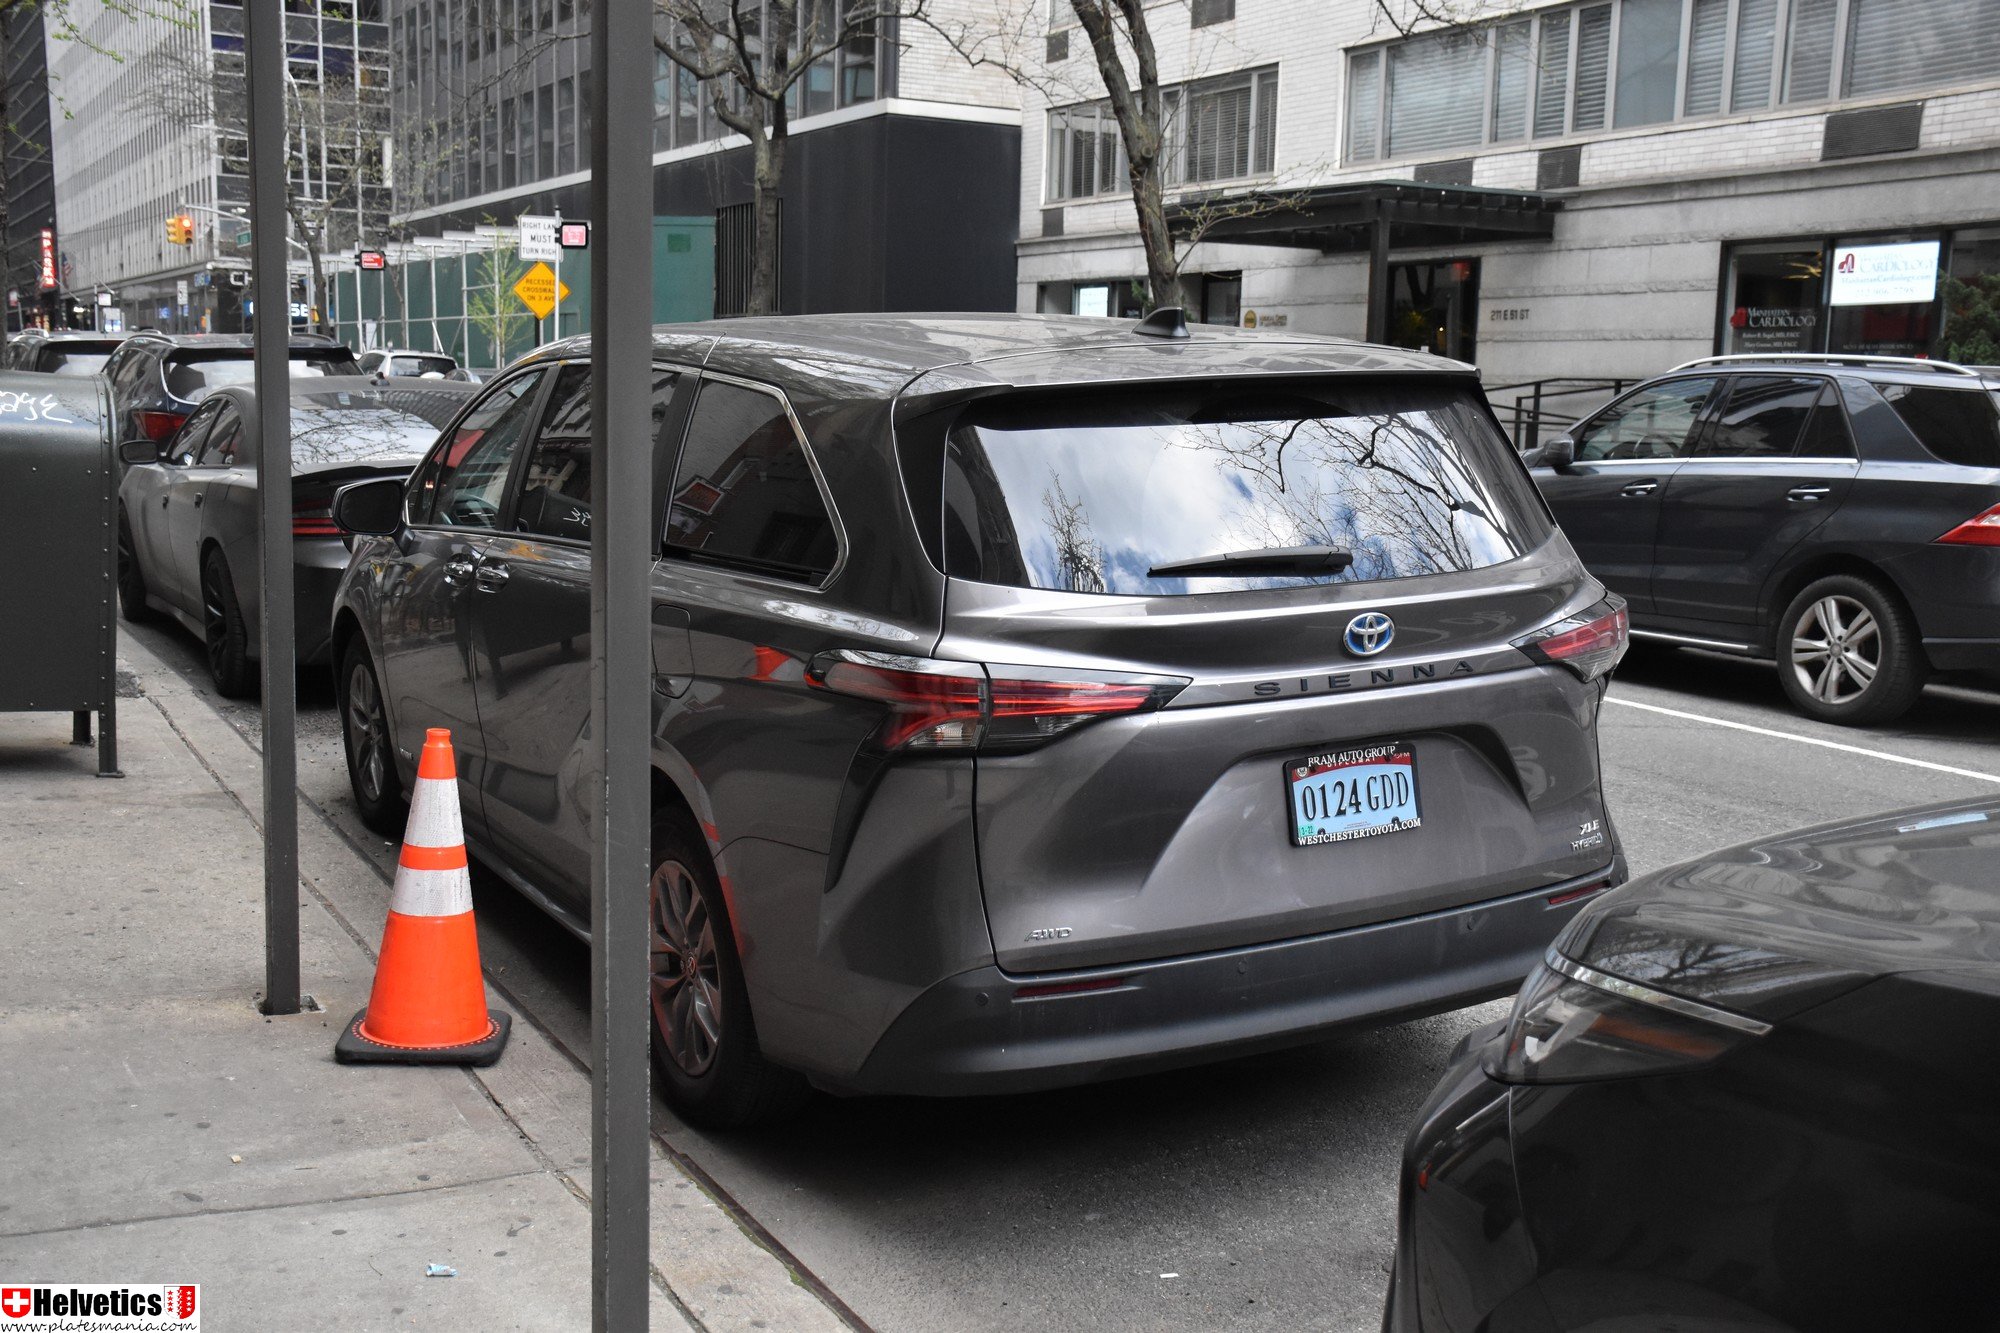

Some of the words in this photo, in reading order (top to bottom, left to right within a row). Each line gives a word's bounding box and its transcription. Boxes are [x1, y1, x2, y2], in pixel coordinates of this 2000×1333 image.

[530, 234, 551, 243] MUST
[1503, 309, 1509, 321] E
[1749, 315, 1818, 328] CARDIOLOGY
[1254, 660, 1474, 696] SIENNA
[1338, 749, 1364, 763] AUTO
[1365, 745, 1396, 760] GROUP
[1302, 777, 1362, 820] 0124
[1366, 772, 1409, 811] GDD
[1298, 817, 1421, 846] WESTCHESTERTOYOTA.COM
[1579, 819, 1600, 836] XLE
[1570, 832, 1603, 851] HYBRID
[1024, 926, 1073, 942] AWD
